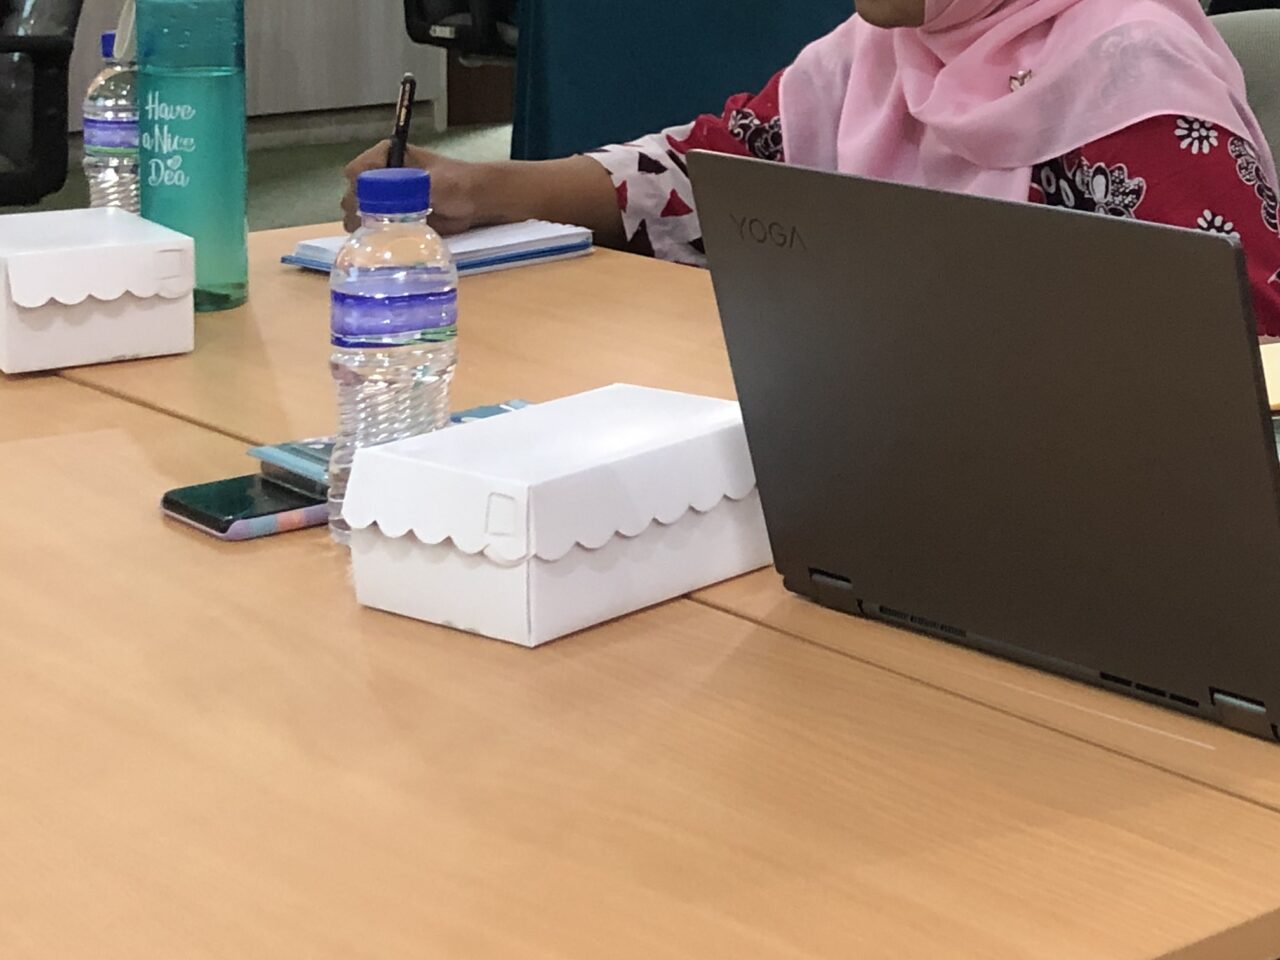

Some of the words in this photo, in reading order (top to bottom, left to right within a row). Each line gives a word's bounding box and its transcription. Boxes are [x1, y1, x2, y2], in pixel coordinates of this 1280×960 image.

[145, 91, 196, 120] Have
[154, 124, 196, 154] Nice
[729, 213, 807, 250] YOGA
